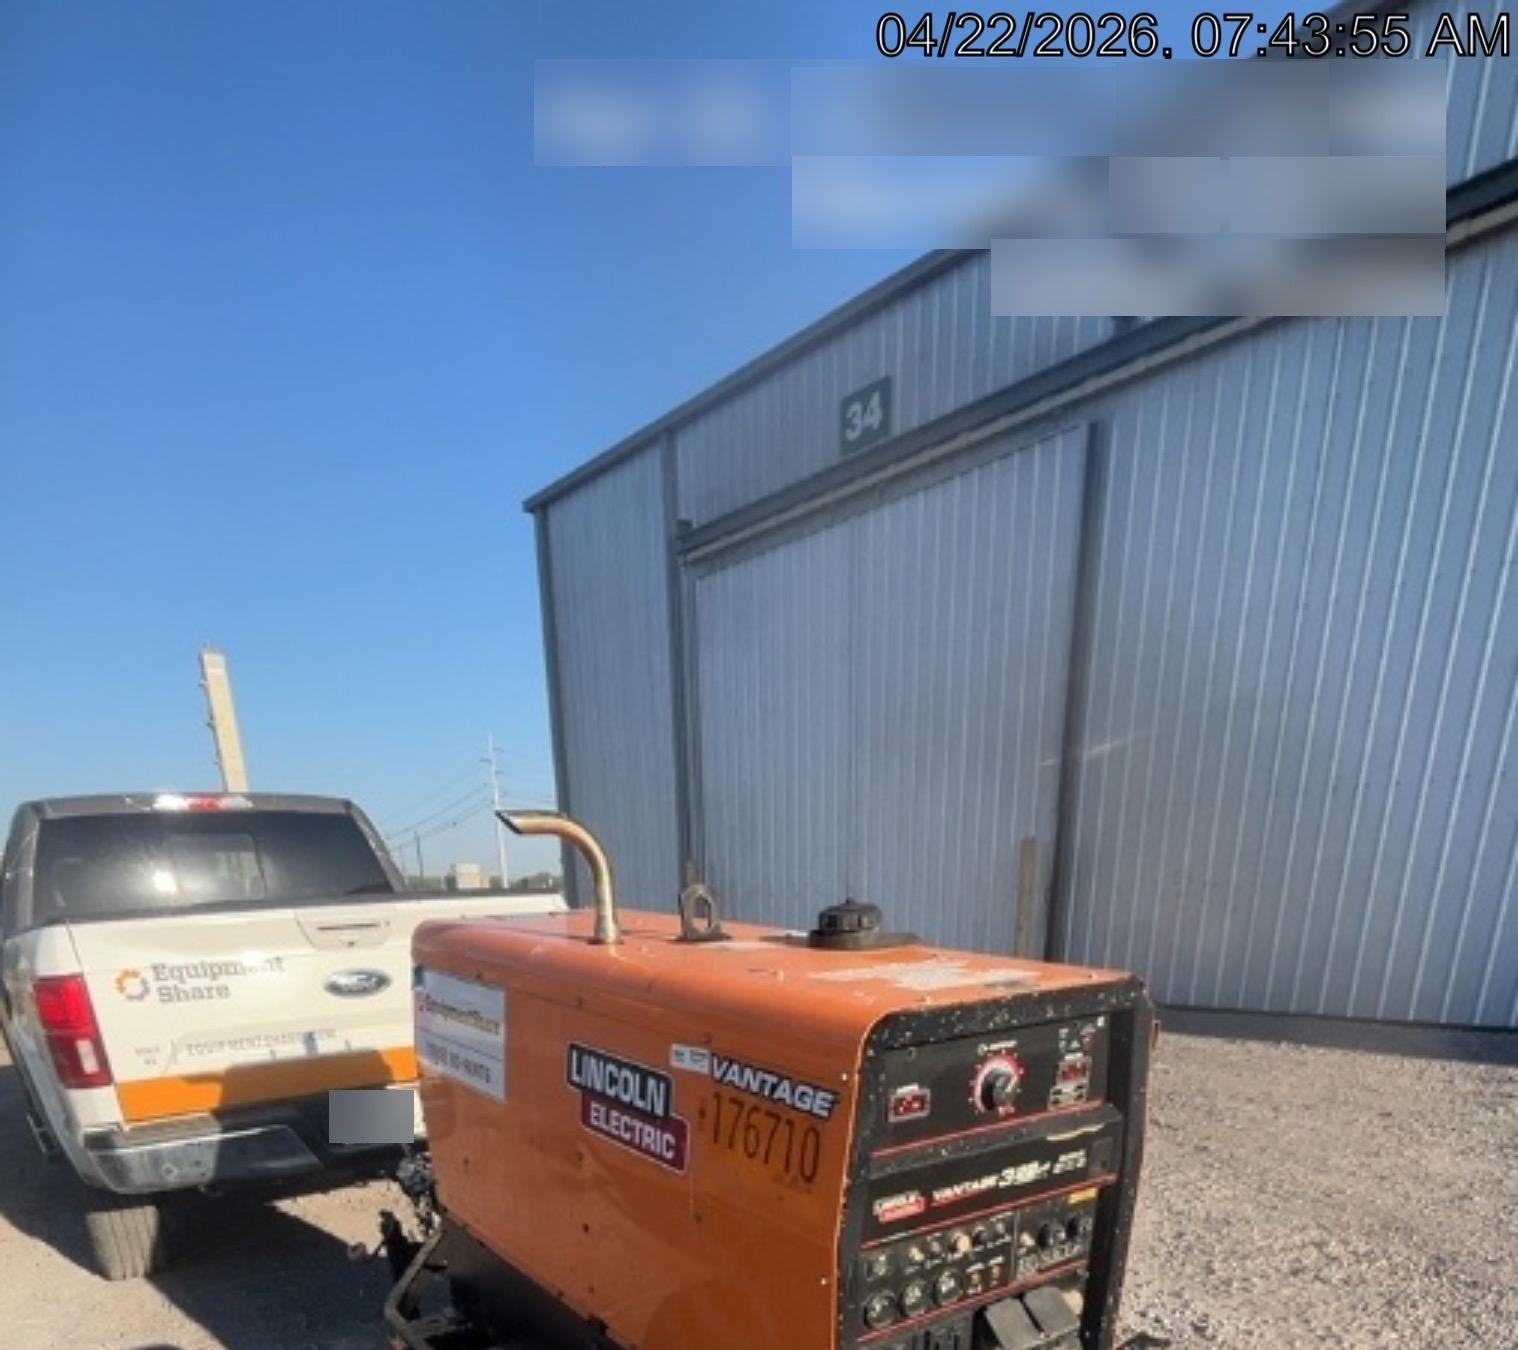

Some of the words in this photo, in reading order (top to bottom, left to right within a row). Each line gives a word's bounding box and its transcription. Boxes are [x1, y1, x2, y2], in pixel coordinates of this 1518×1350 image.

[845, 390, 883, 441] 34
[152, 956, 285, 983] Equipmnt
[157, 983, 230, 1003] Share
[572, 1048, 666, 1117] LINCOLN
[713, 1055, 837, 1117] VANTAGE
[590, 1101, 676, 1160] ELECTRIC
